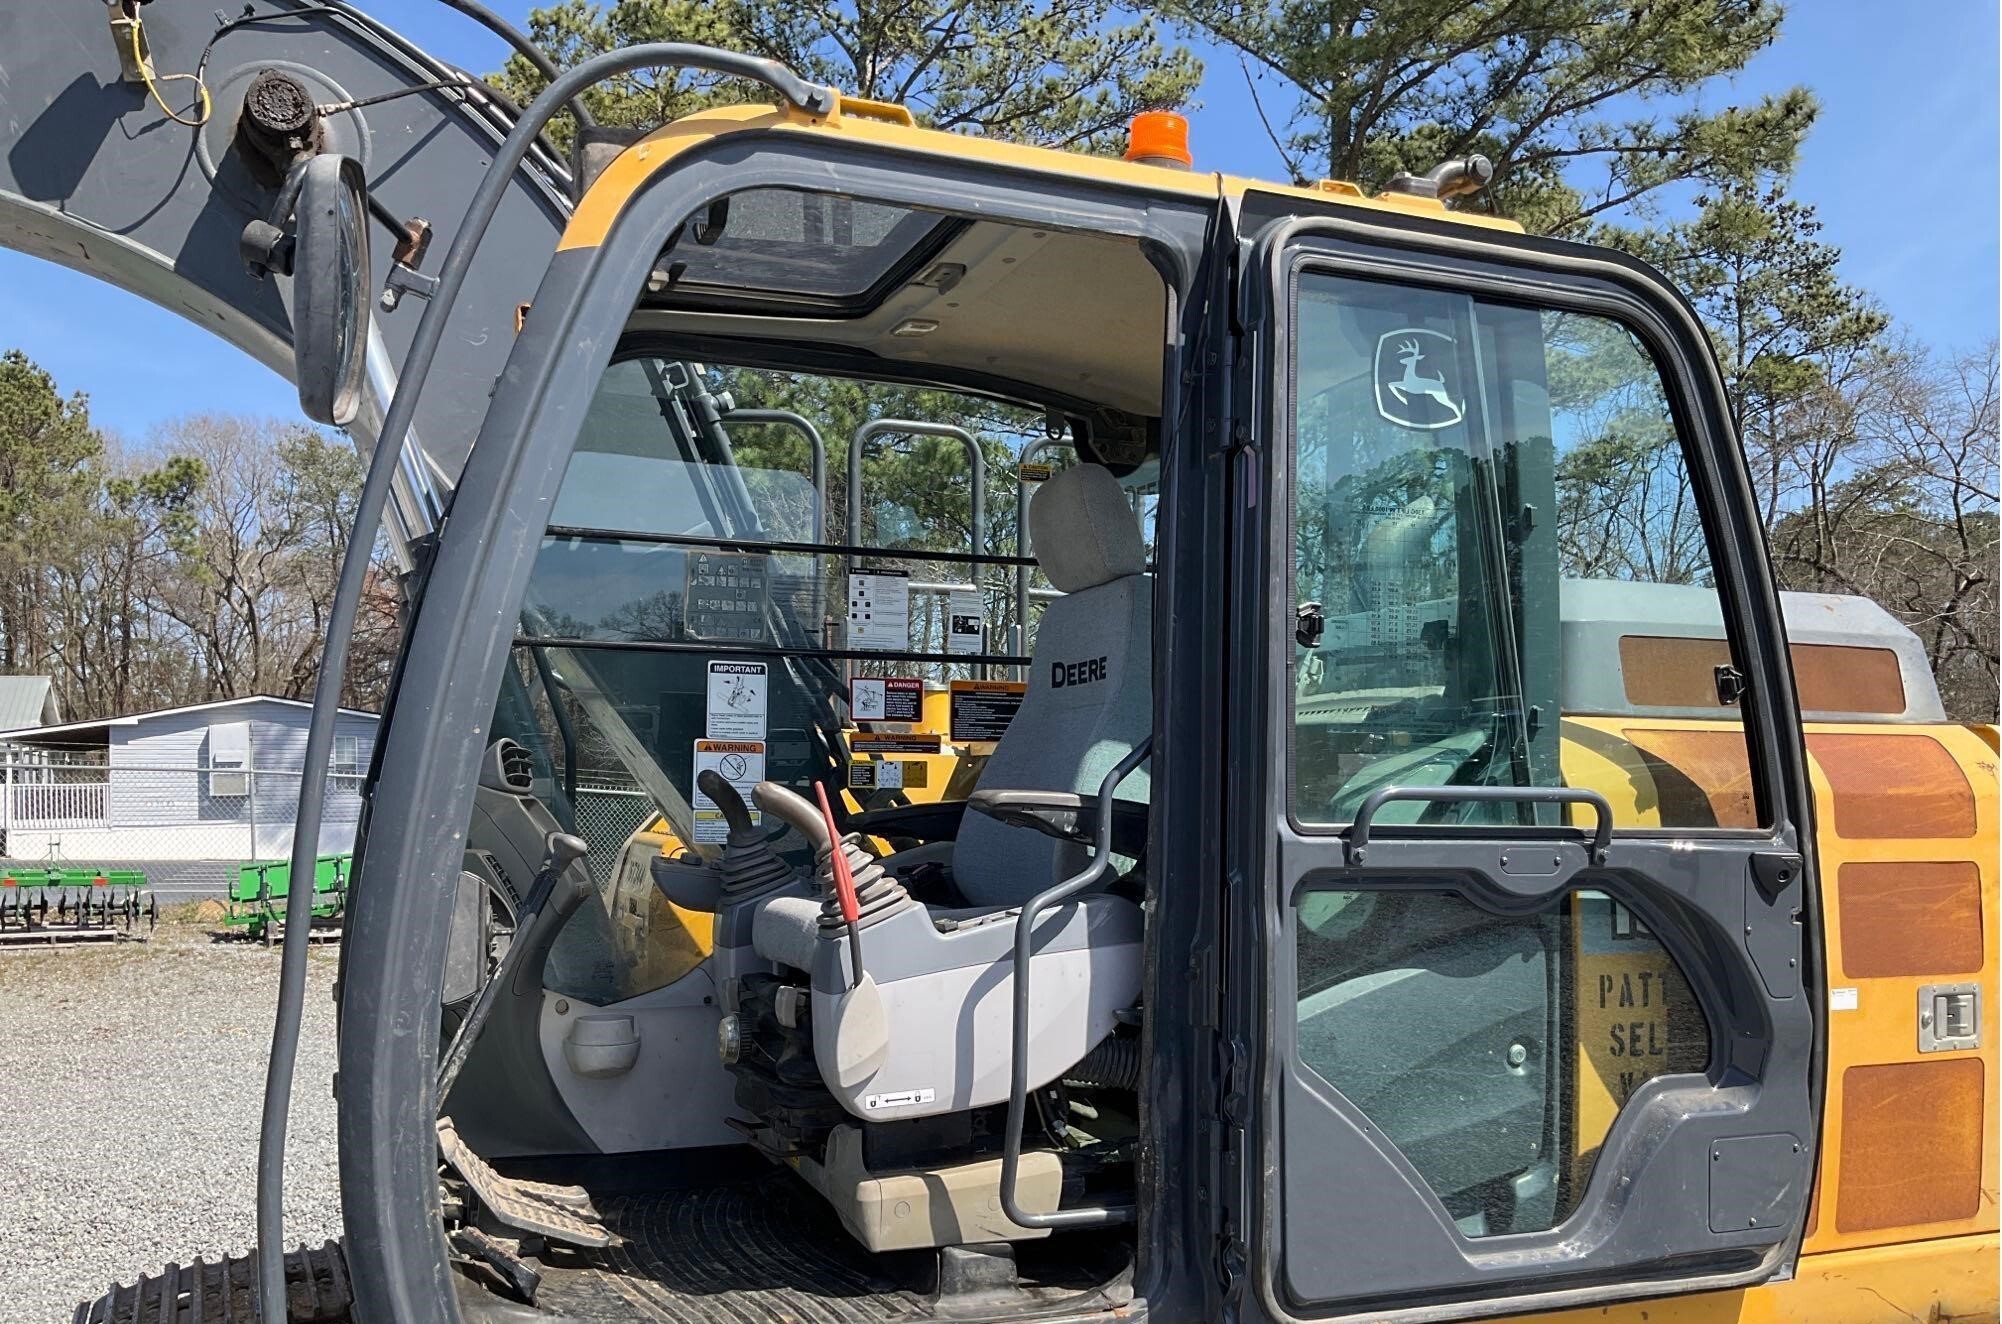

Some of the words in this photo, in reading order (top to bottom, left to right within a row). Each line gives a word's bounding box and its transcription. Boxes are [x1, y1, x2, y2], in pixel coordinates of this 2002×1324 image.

[714, 664, 762, 674] IMPORTANT
[1051, 656, 1108, 689] DEERE
[713, 743, 757, 752] WARNING
